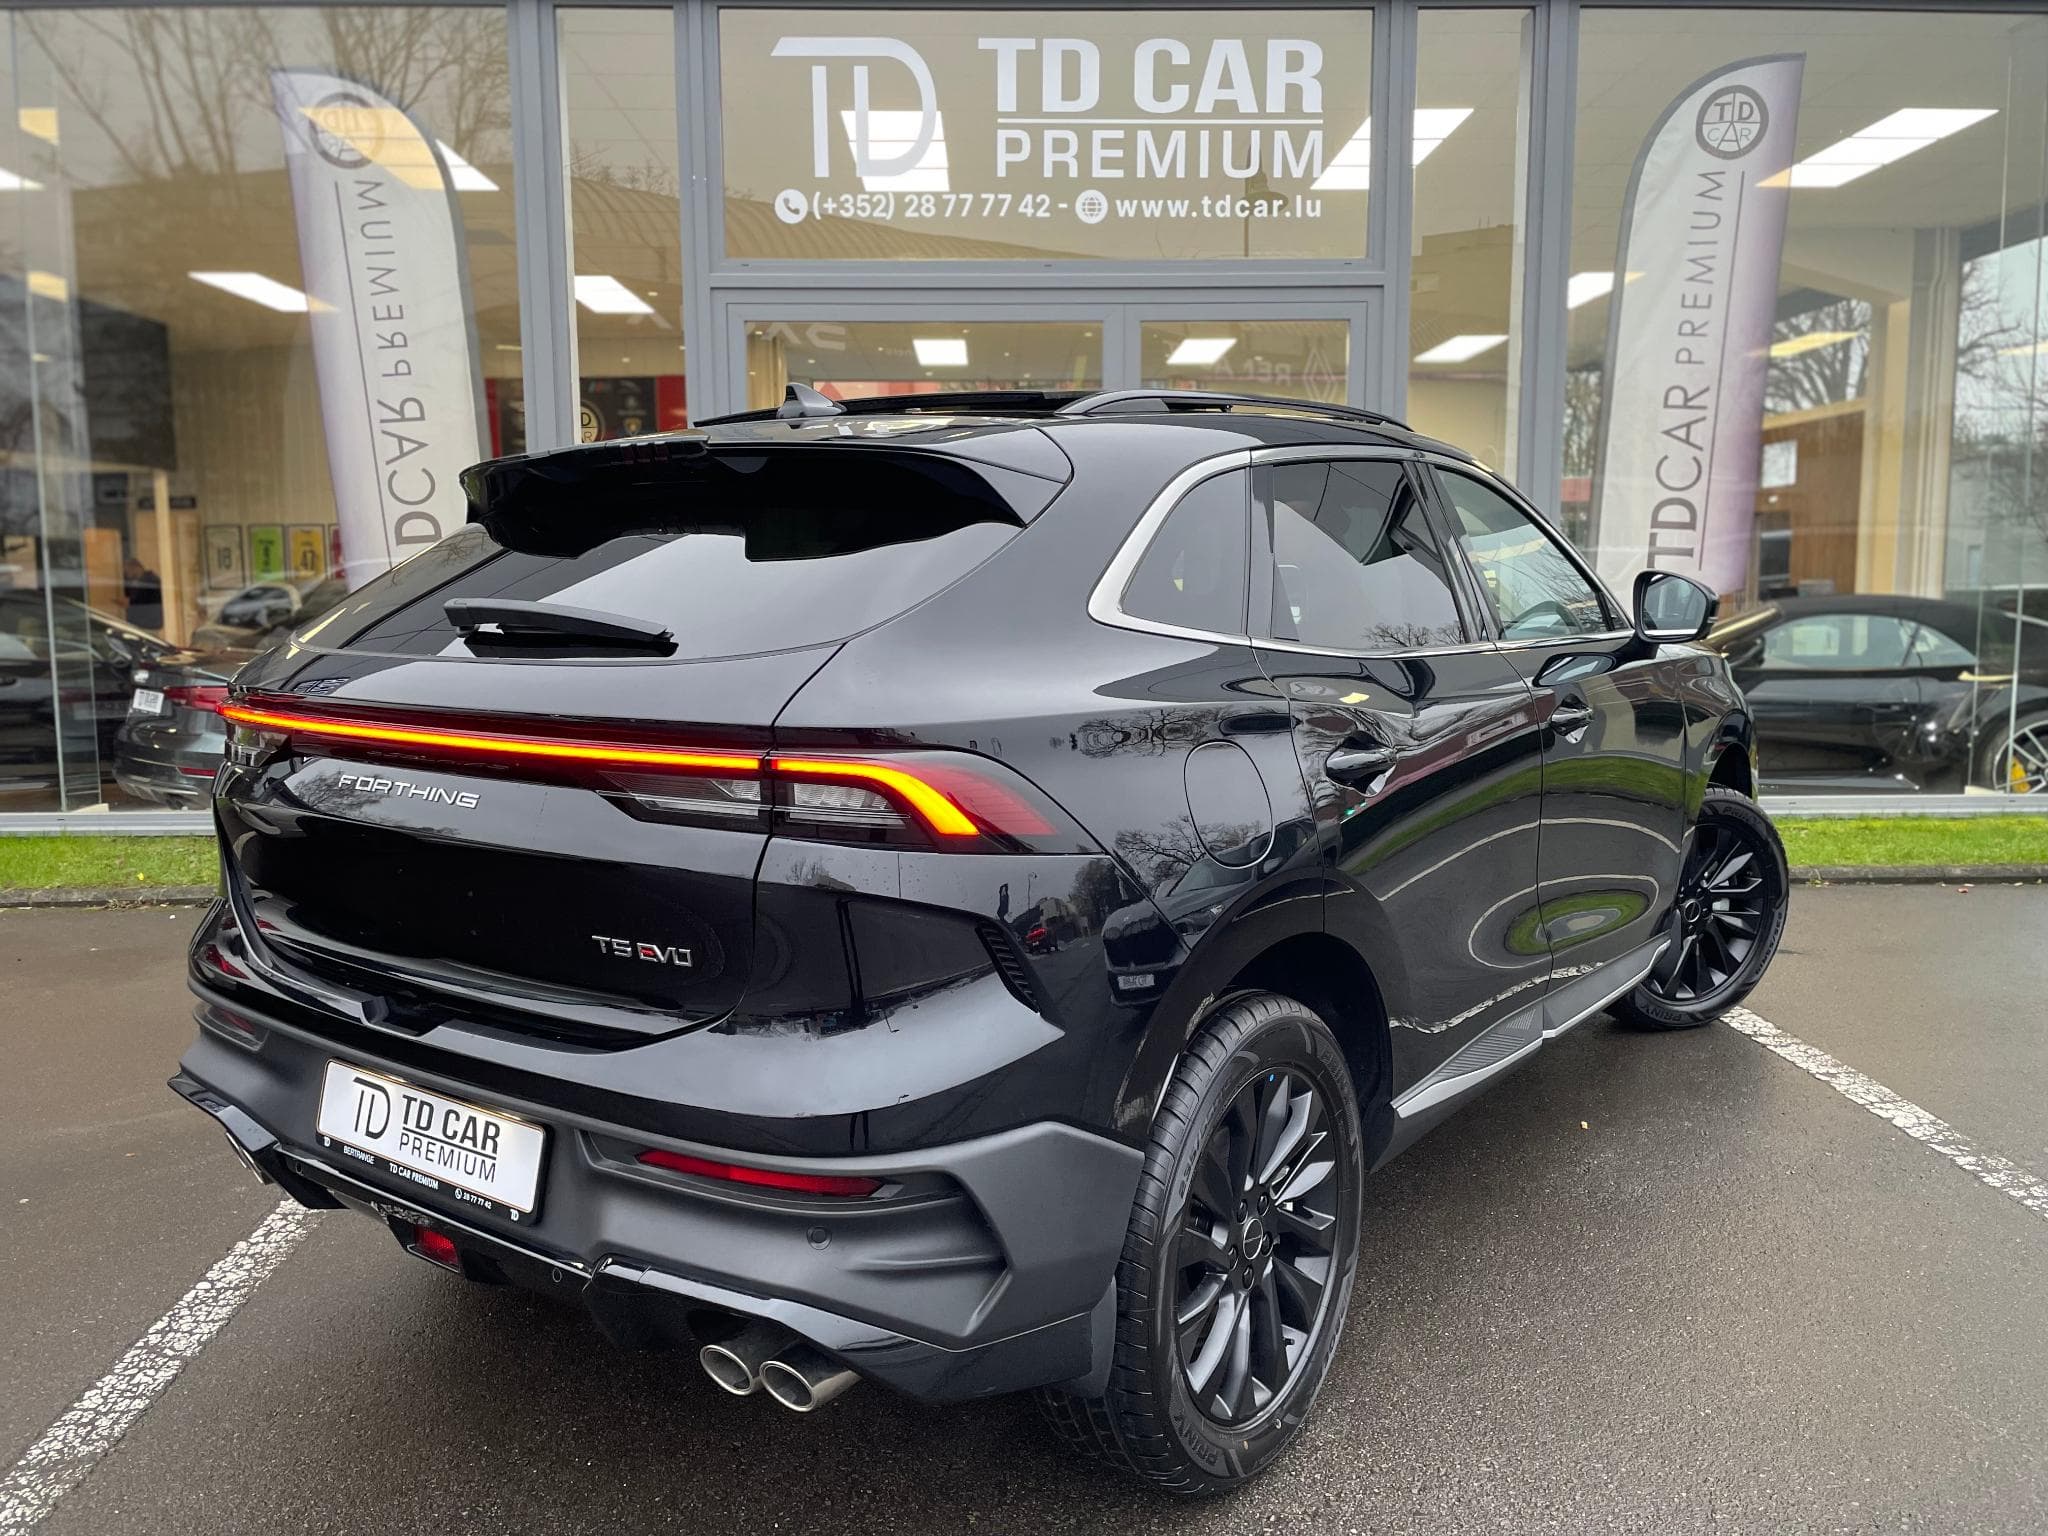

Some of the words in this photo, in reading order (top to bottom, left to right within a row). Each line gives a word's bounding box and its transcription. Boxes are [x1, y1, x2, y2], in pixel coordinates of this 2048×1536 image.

[978, 37, 1101, 113] TD
[1133, 38, 1324, 114] CAR
[1713, 101, 1754, 121] TD
[996, 130, 1323, 178] PREMIUM
[812, 193, 895, 220] (+352)
[904, 195, 936, 218] 28
[941, 195, 973, 218] 77
[980, 195, 1012, 218] 77
[1017, 195, 1051, 218] 42
[1115, 195, 1322, 218] www.tdcar.lu
[1676, 169, 1727, 365] PREMIUM
[1647, 383, 1710, 569] TDCAR
[338, 774, 480, 809] FORTHING
[402, 1094, 435, 1132] TD
[442, 1109, 501, 1154] CAR
[399, 1133, 497, 1183] PREMIUM
[411, 1171, 439, 1190] PREMIUM
